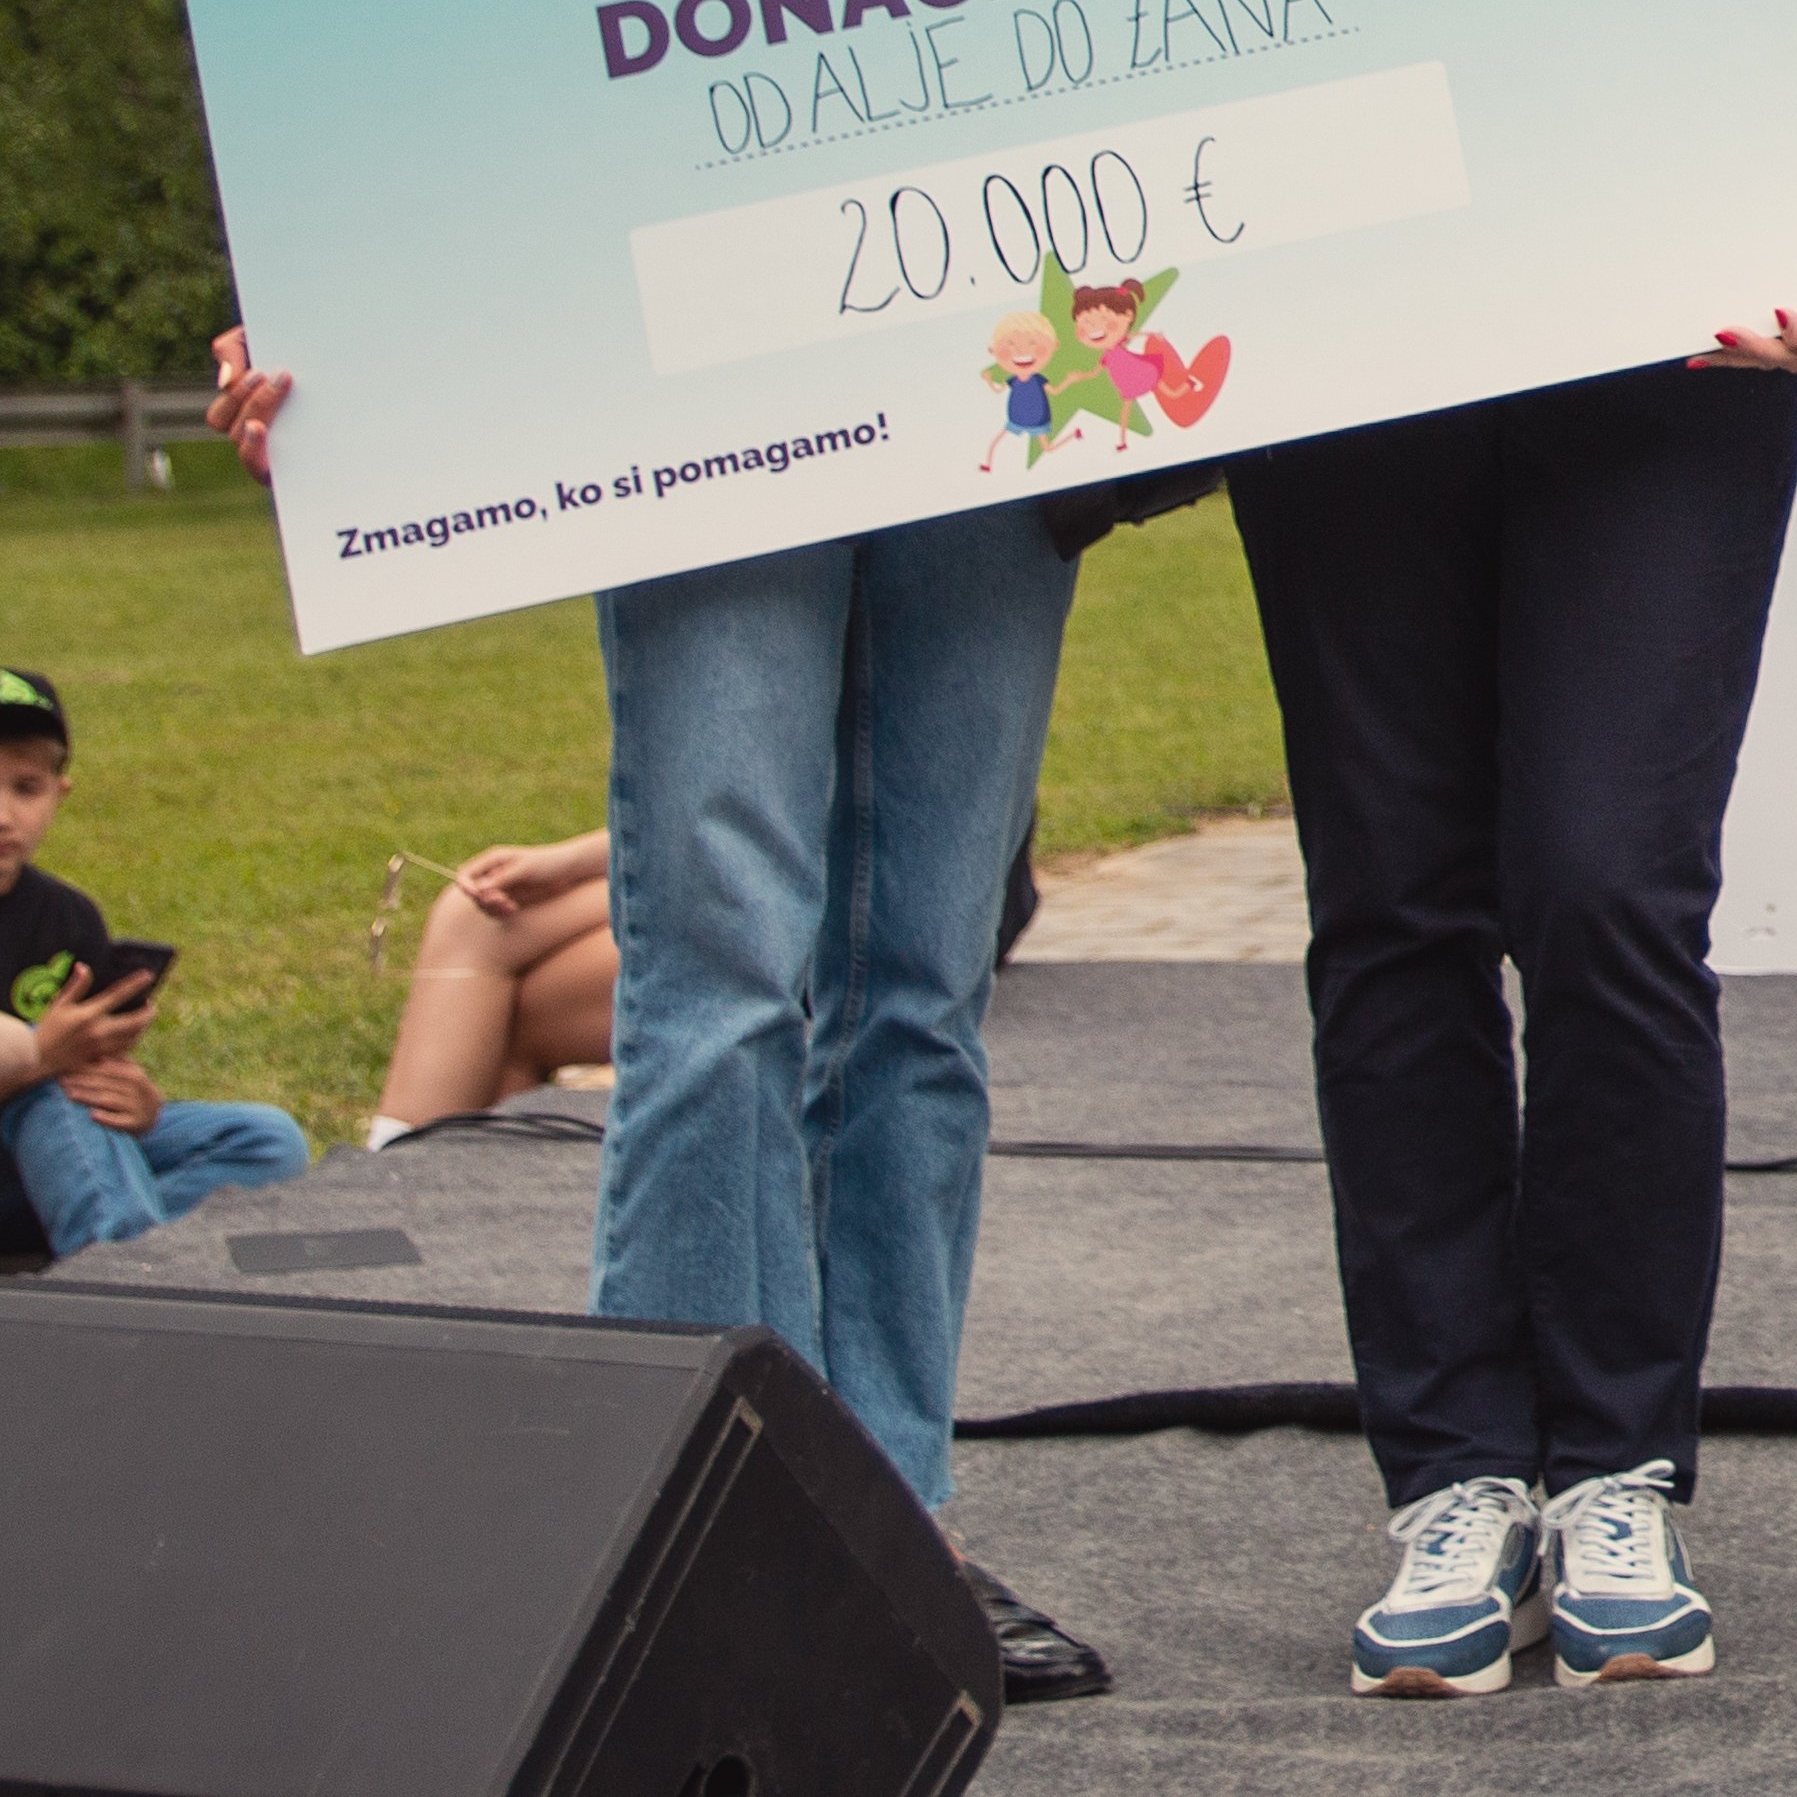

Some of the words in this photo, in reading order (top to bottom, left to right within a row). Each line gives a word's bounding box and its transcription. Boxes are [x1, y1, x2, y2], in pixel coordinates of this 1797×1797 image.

[708, 71, 793, 155] OD
[811, 16, 994, 134] ALJE
[838, 149, 1149, 315] 20.000
[1183, 136, 1246, 244] €
[335, 497, 549, 561] Zmagamo,
[554, 481, 604, 513] ko
[614, 464, 645, 501] si
[651, 411, 891, 500] pomagamo!
